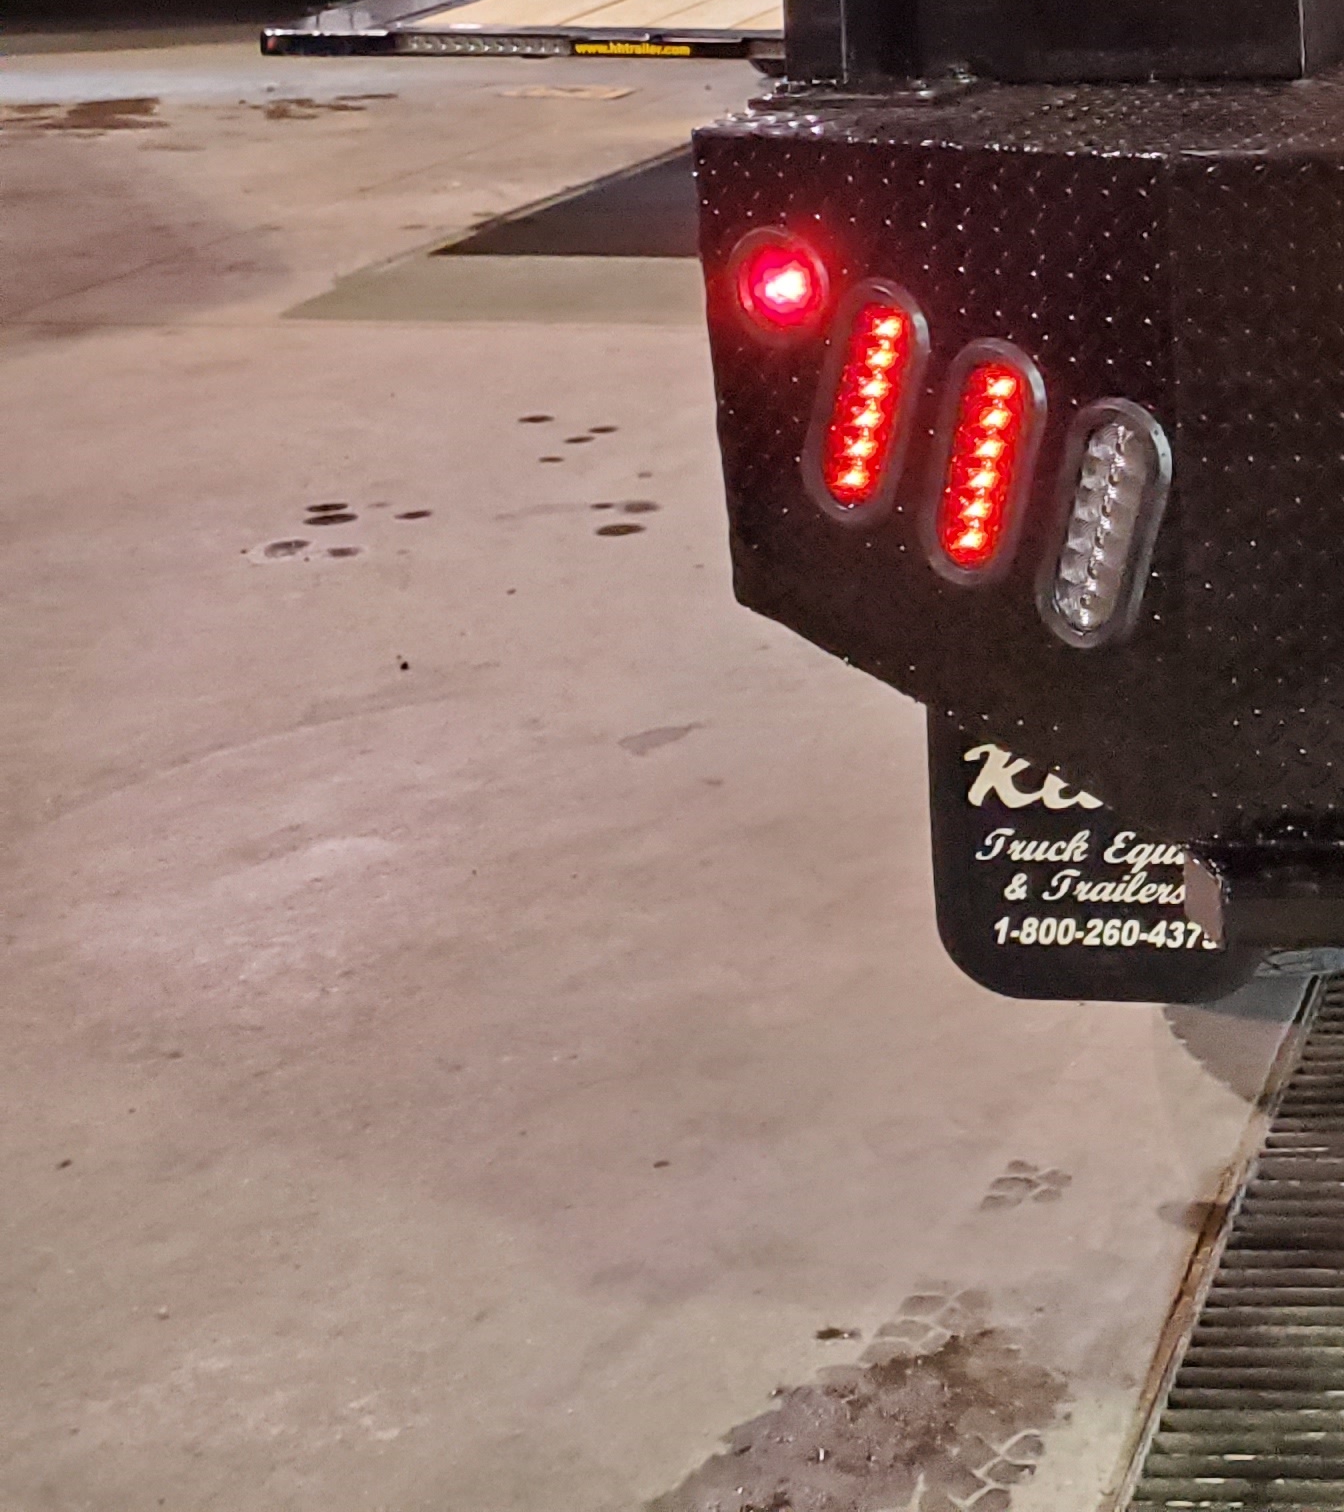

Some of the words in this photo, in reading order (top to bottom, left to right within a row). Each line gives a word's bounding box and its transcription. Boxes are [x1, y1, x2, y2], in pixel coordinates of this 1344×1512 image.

[975, 828, 1090, 861] Truck
[1104, 831, 1186, 873] Equ
[1004, 873, 1028, 900] &
[1042, 868, 1186, 904] Trailers
